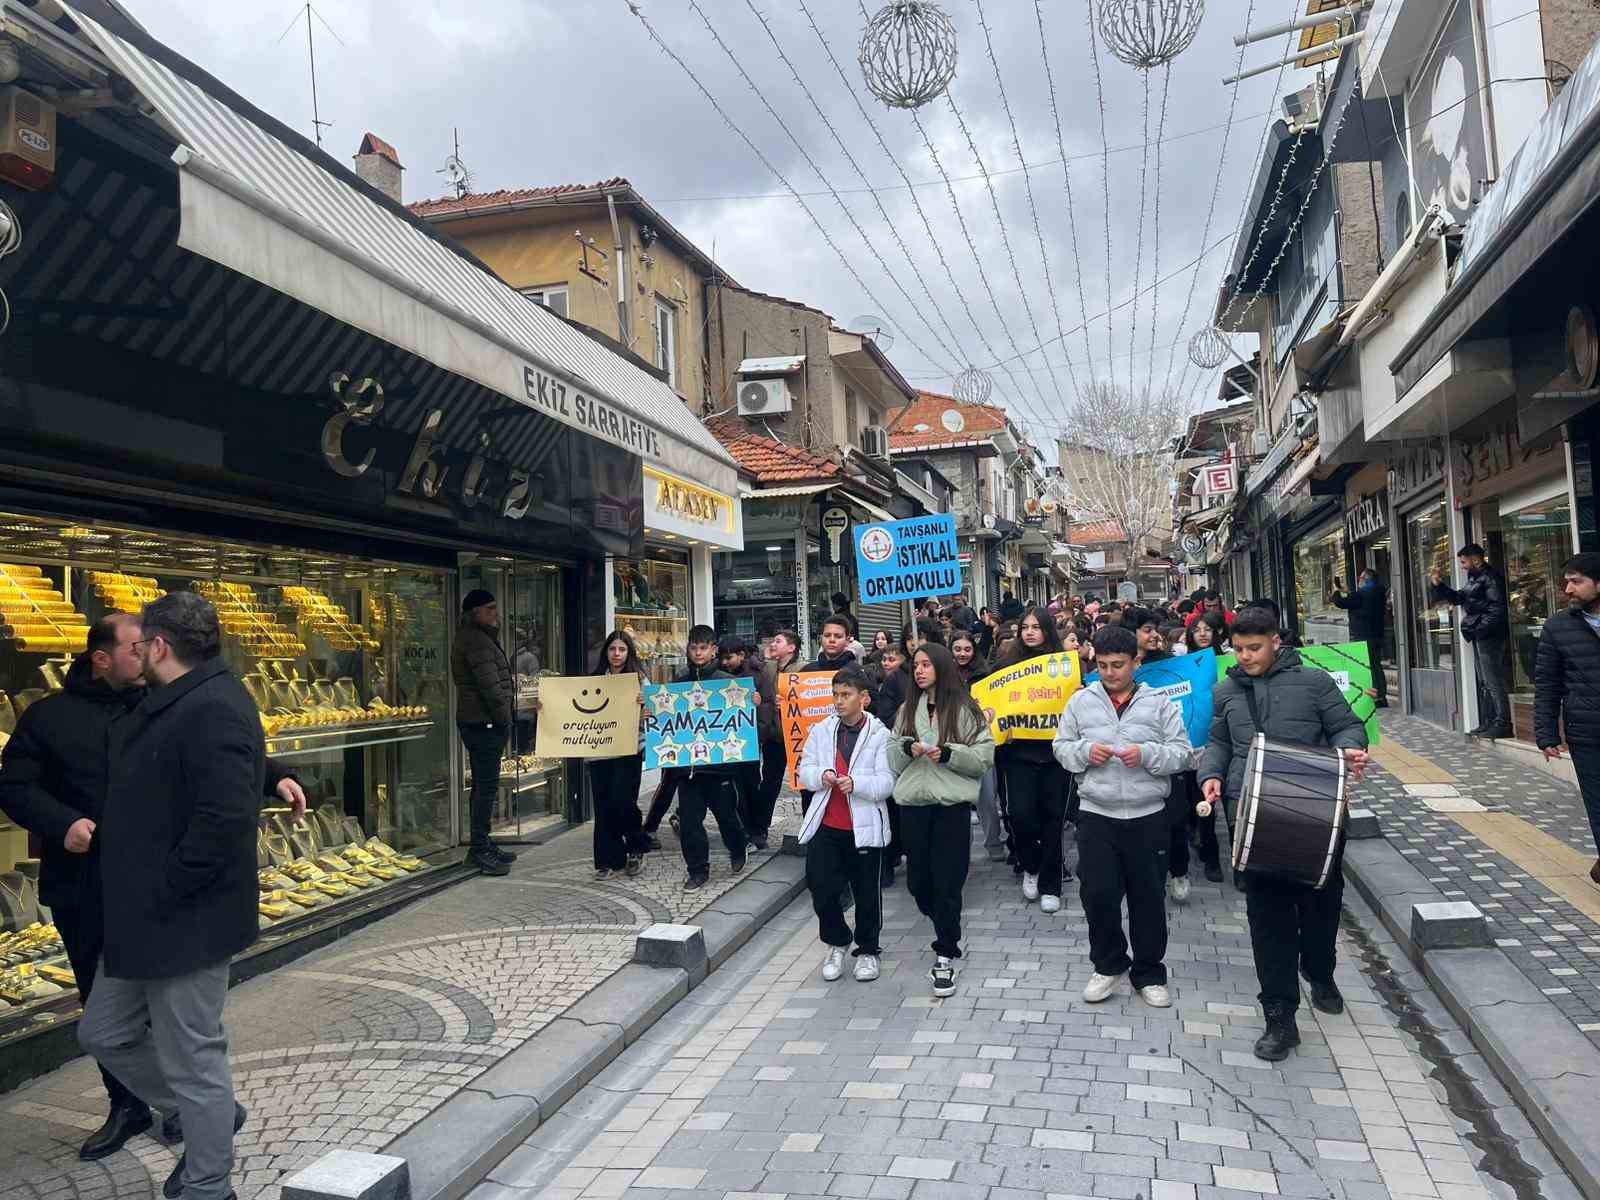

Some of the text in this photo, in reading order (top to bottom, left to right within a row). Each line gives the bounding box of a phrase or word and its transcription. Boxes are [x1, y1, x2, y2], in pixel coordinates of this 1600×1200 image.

[575, 393, 661, 458] SARRAFİYE
[1213, 472, 1228, 488] E
[897, 521, 949, 540] TAVŞANLI
[895, 540, 957, 568] İSTİKLAL
[865, 568, 956, 598] ORTAOKULU
[562, 719, 618, 735] oruçluyum
[643, 708, 756, 737] RAMAZAN
[562, 733, 614, 749] mutluyum
